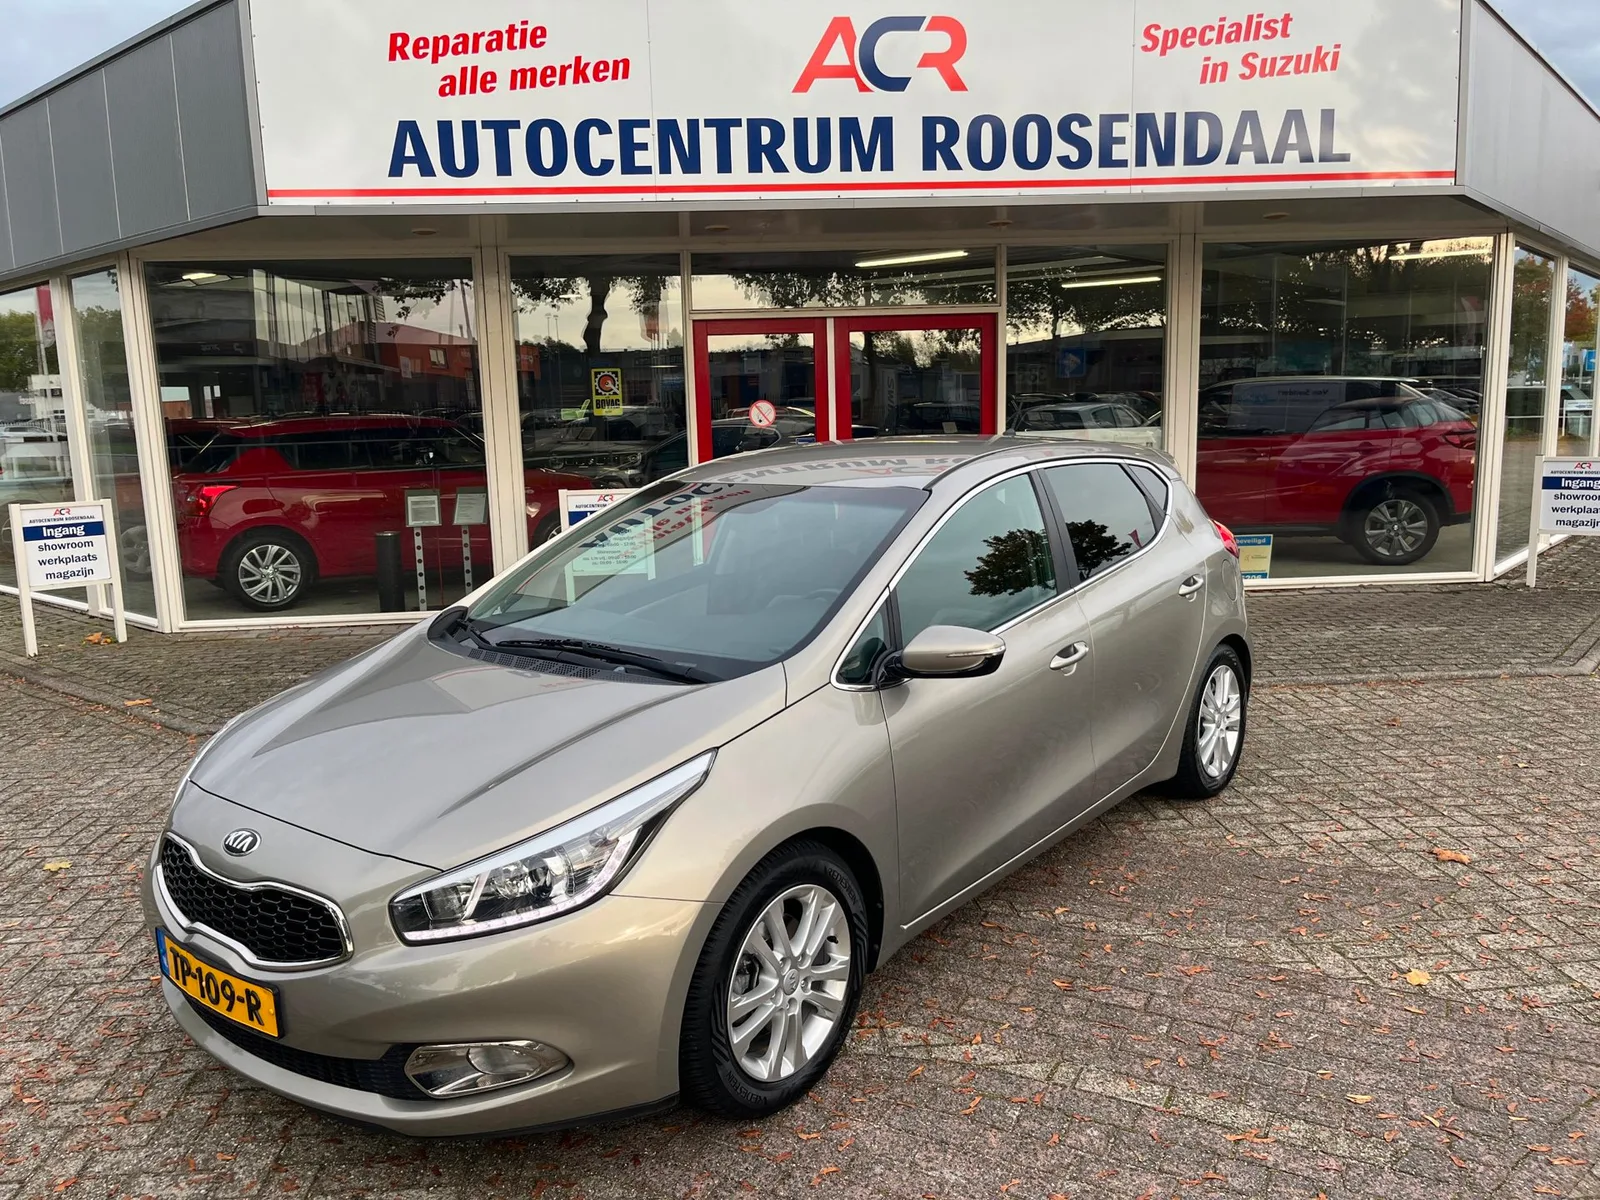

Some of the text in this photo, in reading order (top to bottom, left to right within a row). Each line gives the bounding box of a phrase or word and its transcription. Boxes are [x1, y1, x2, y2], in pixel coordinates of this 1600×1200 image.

[388, 20, 547, 64] Reparatie
[1141, 13, 1293, 57] Specialist
[791, 15, 969, 93] ACR
[1199, 43, 1342, 85] in Suzuki
[438, 55, 630, 97] alle merken
[387, 107, 1351, 178] AUTOCENTRUM ROOSENDAAL
[595, 398, 621, 409] BOVAG
[1574, 462, 1592, 470] ACR
[597, 494, 615, 502] ACR
[53, 508, 71, 516] ACR
[42, 524, 86, 538] Ingang
[37, 540, 94, 552] showroom
[37, 552, 98, 567] werkplaats
[45, 567, 94, 580] magazijn
[224, 830, 254, 852] KIA
[169, 946, 265, 1027] TP-109-R
